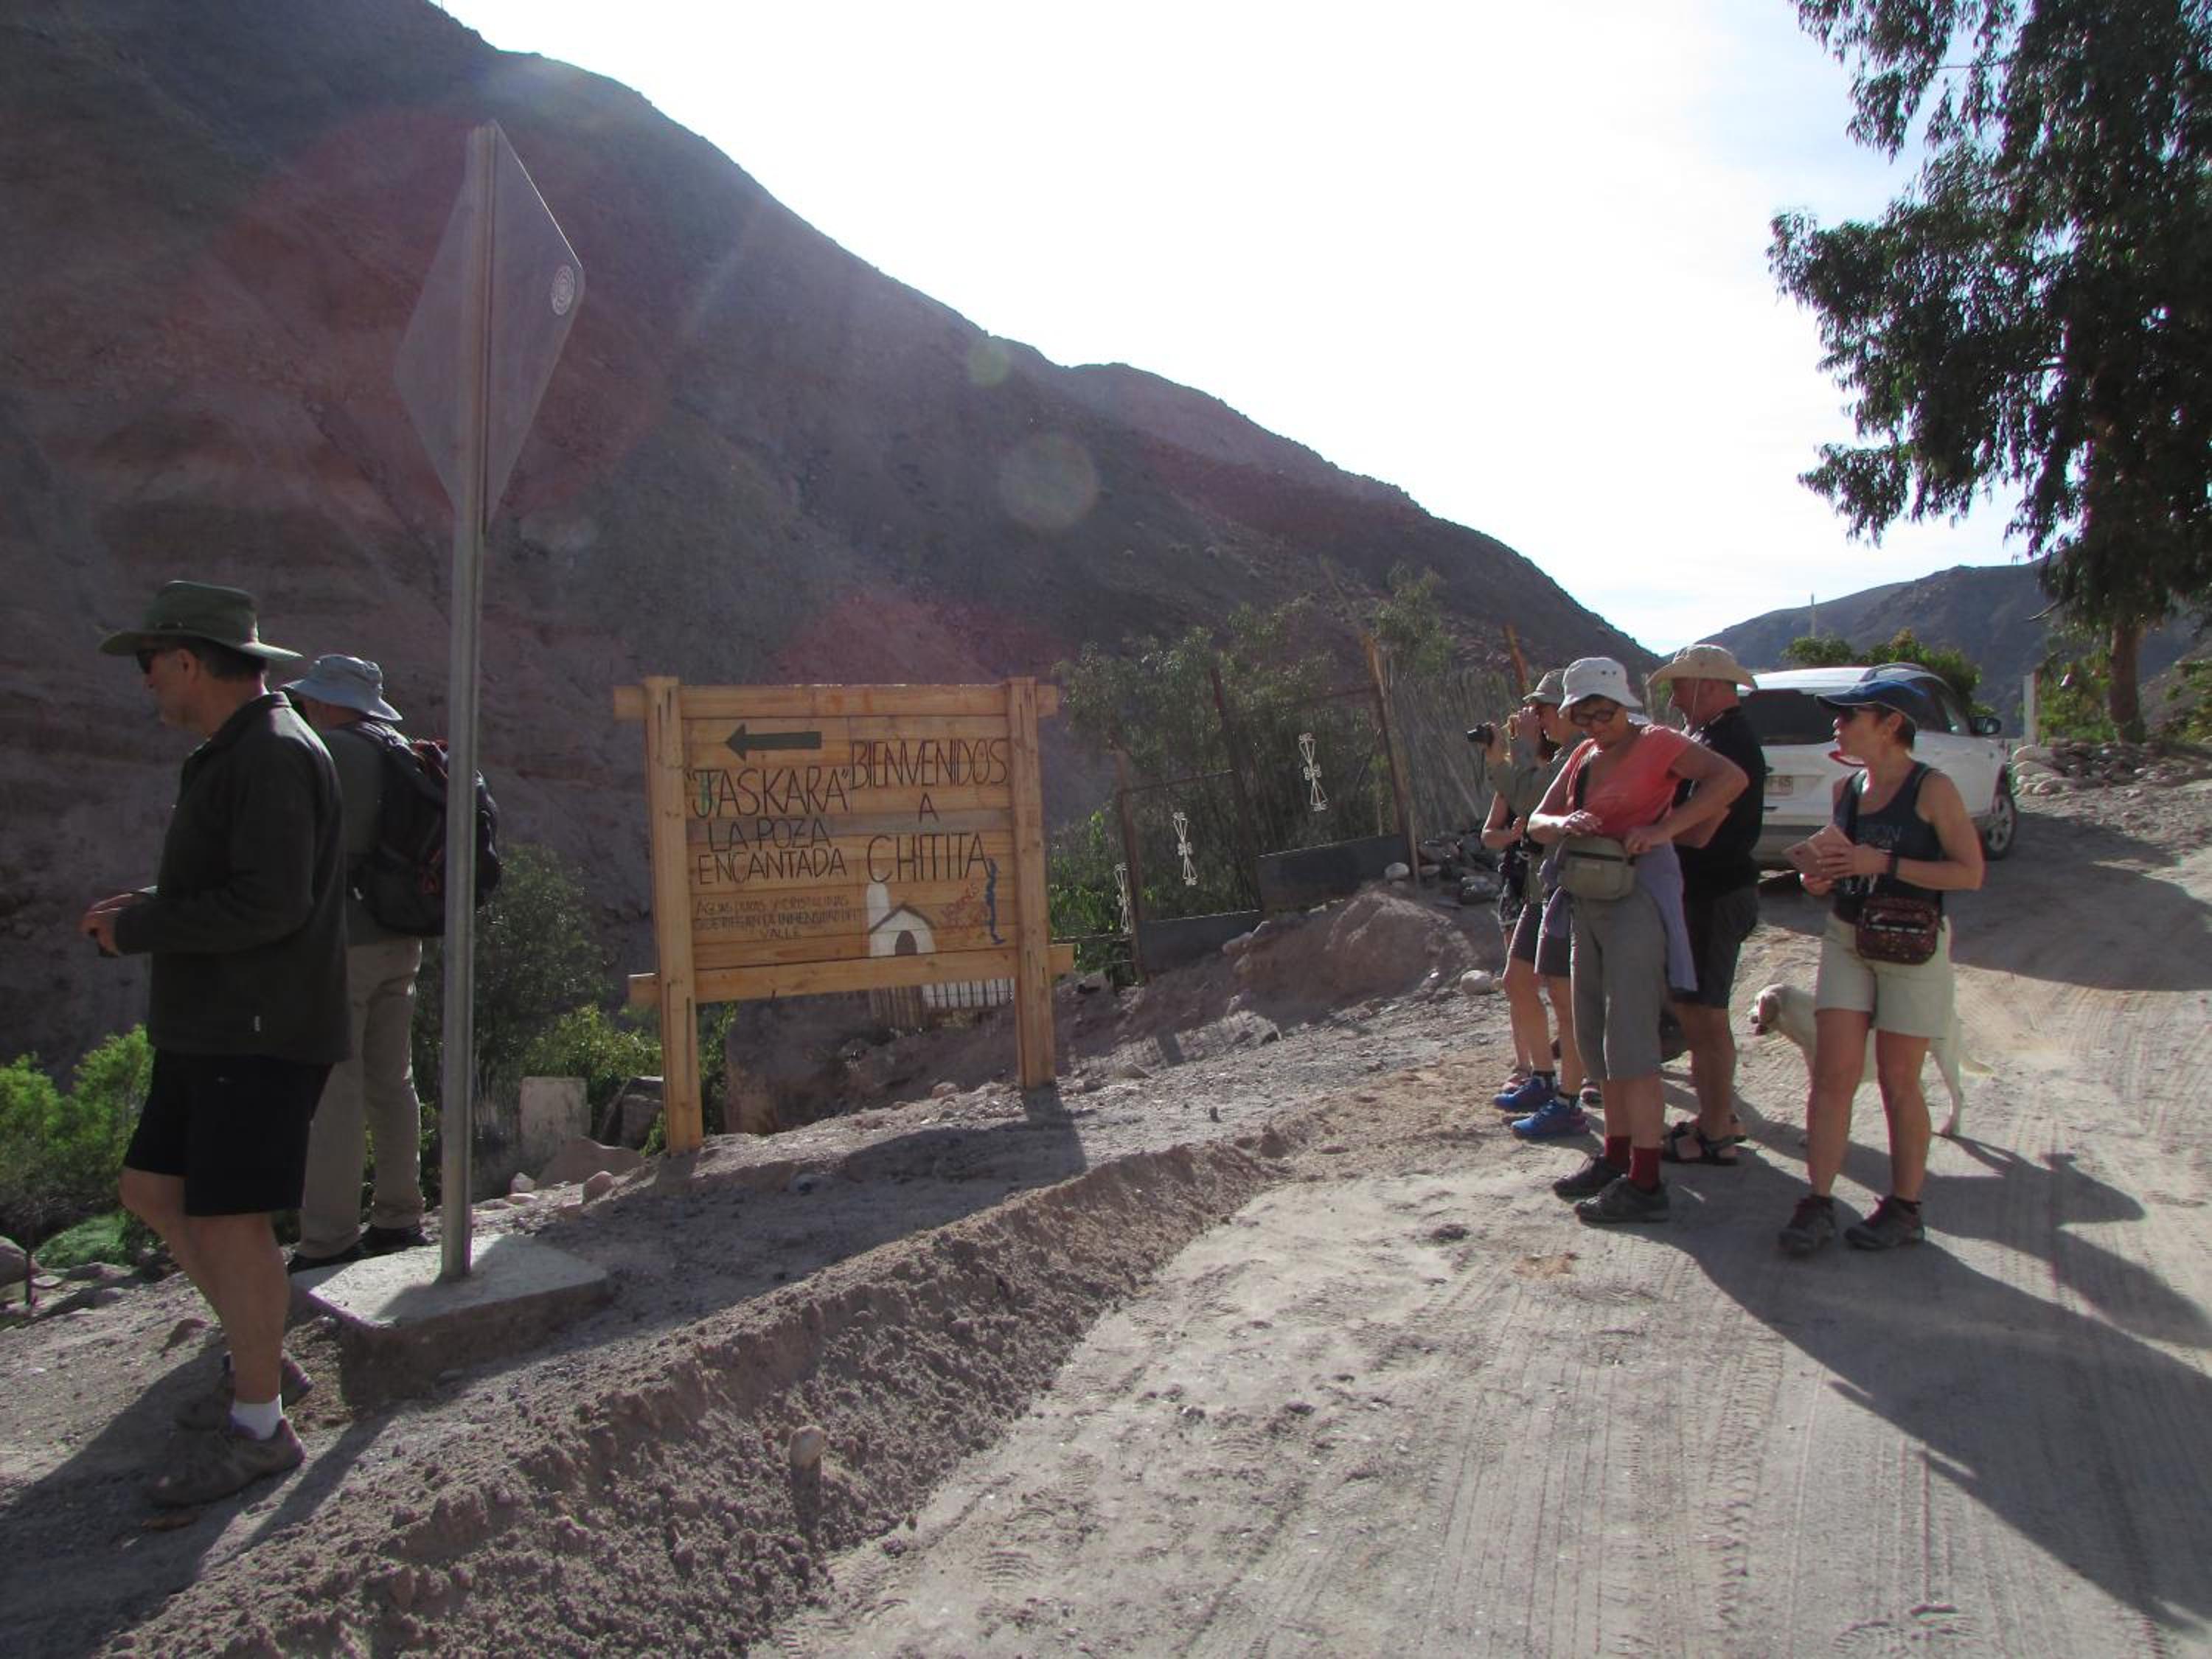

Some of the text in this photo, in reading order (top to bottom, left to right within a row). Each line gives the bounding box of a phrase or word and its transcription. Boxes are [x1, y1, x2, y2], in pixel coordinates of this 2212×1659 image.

[849, 738, 1008, 790] BIENVENIDOS
[919, 792, 940, 823] A
[708, 816, 832, 852] LA POZA
[698, 848, 848, 886] ENCANTADA
[867, 831, 991, 883] CHITITA
